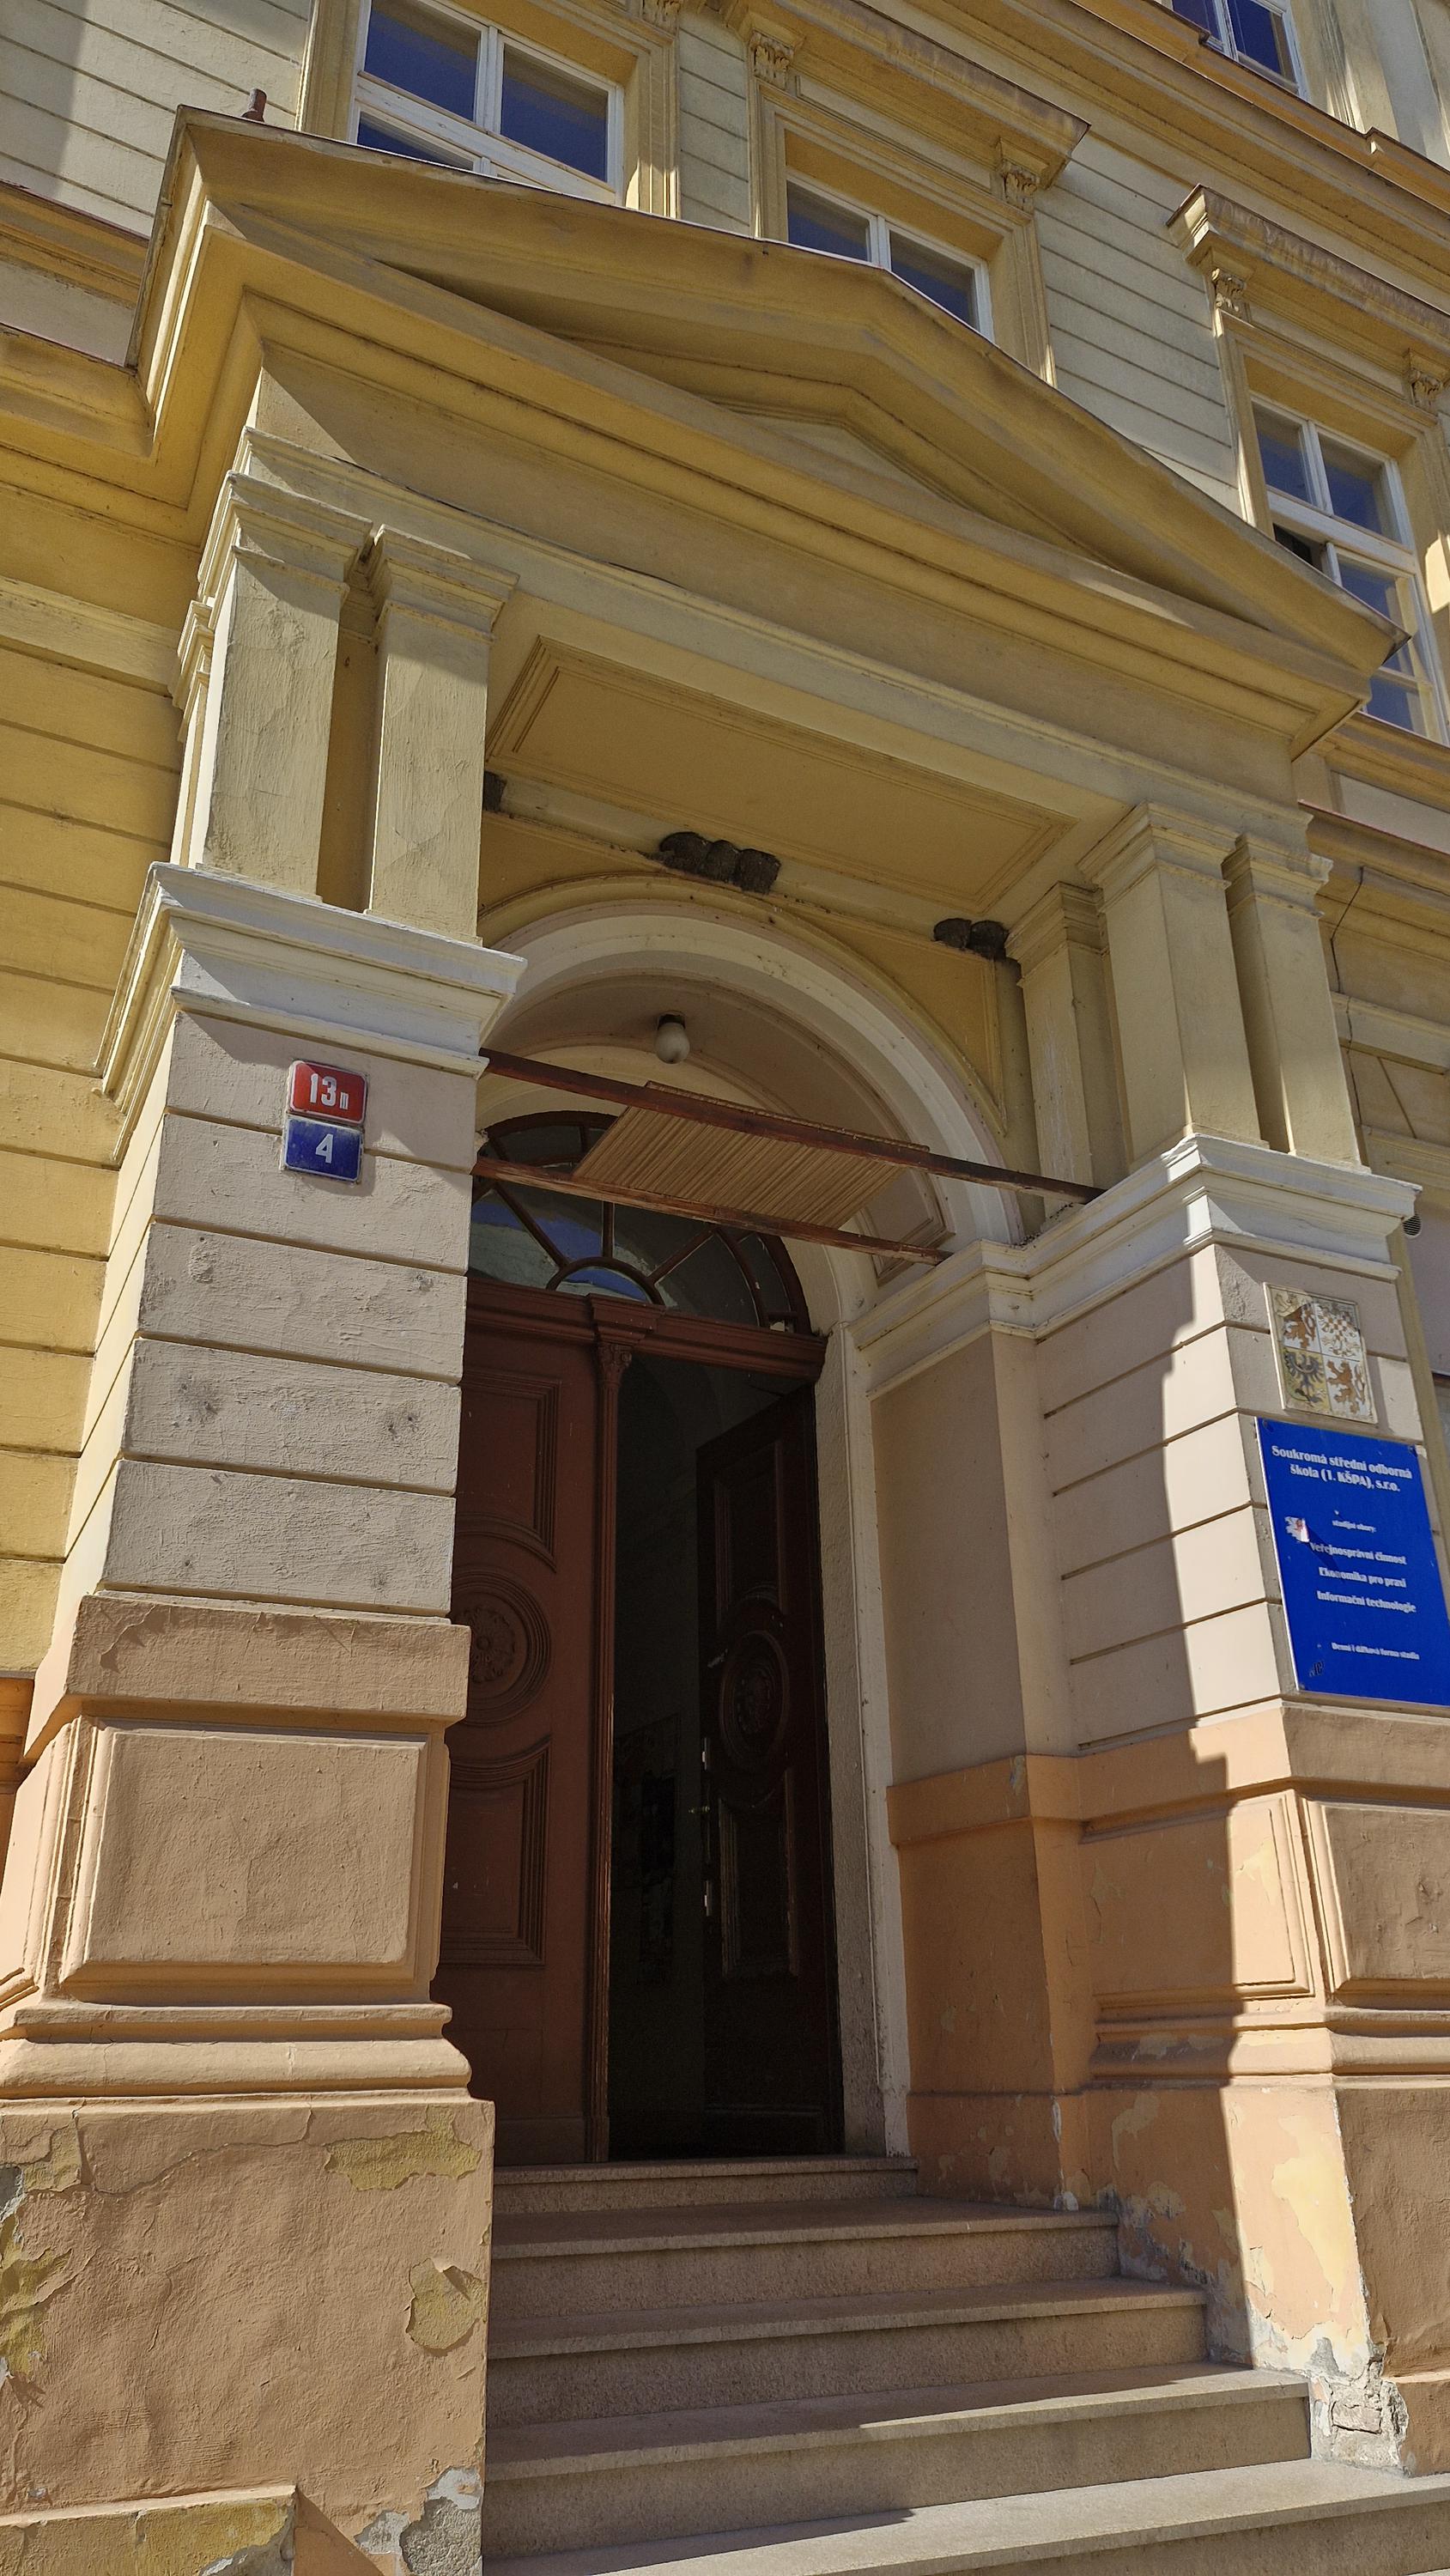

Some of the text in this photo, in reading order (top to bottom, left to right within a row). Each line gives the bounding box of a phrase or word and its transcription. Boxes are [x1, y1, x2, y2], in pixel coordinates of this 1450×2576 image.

[315, 1133, 334, 1163] 4
[1271, 1445, 1412, 1479] Soukromá střední odborná
[1289, 1463, 1320, 1479] škola
[1320, 1468, 1336, 1482] (1.
[1375, 1479, 1400, 1492] s.r.o.
[1309, 1541, 1374, 1559] Veřejnosprávní
[1319, 1566, 1407, 1589] Ekonomika pro praxi
[1316, 1589, 1417, 1613] Informační technologie
